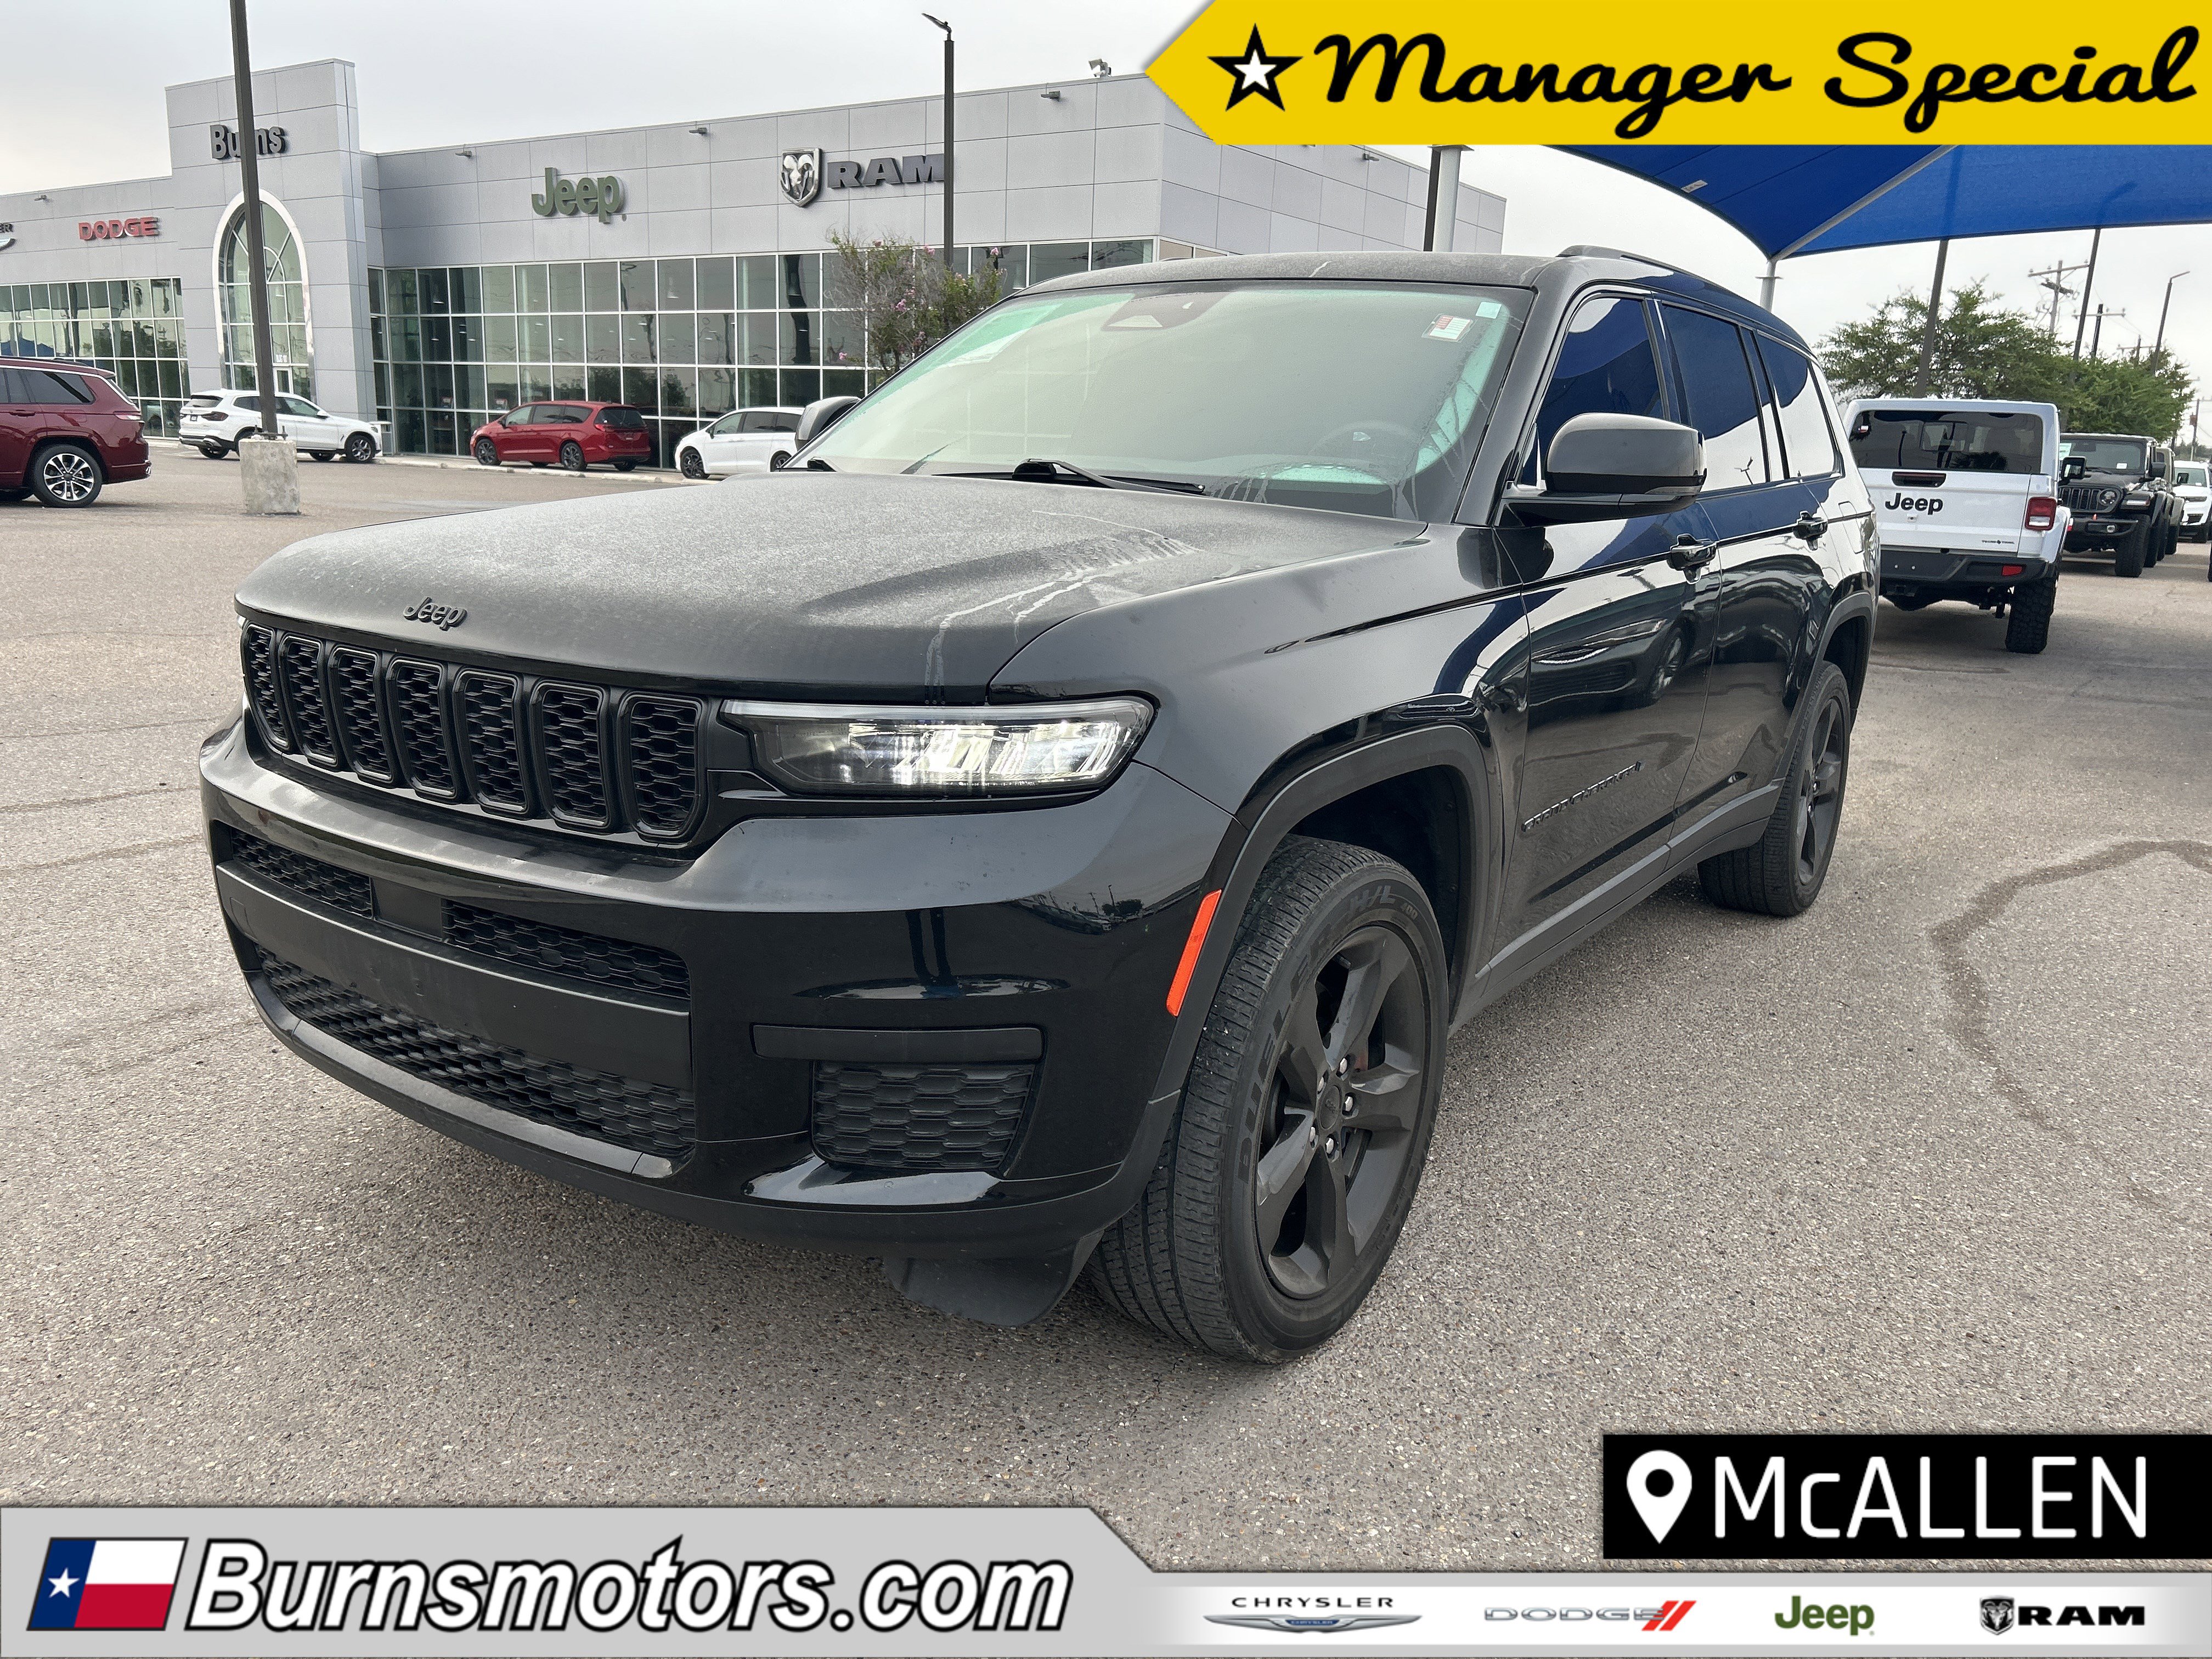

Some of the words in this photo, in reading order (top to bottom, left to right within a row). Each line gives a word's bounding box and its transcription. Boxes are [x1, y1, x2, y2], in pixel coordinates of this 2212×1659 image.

[210, 125, 285, 159] Buns
[827, 153, 945, 189] RAM
[531, 167, 625, 224] Jeep
[78, 216, 159, 240] DODGE
[1884, 492, 1944, 515] Jeep
[403, 596, 467, 631] Jeep
